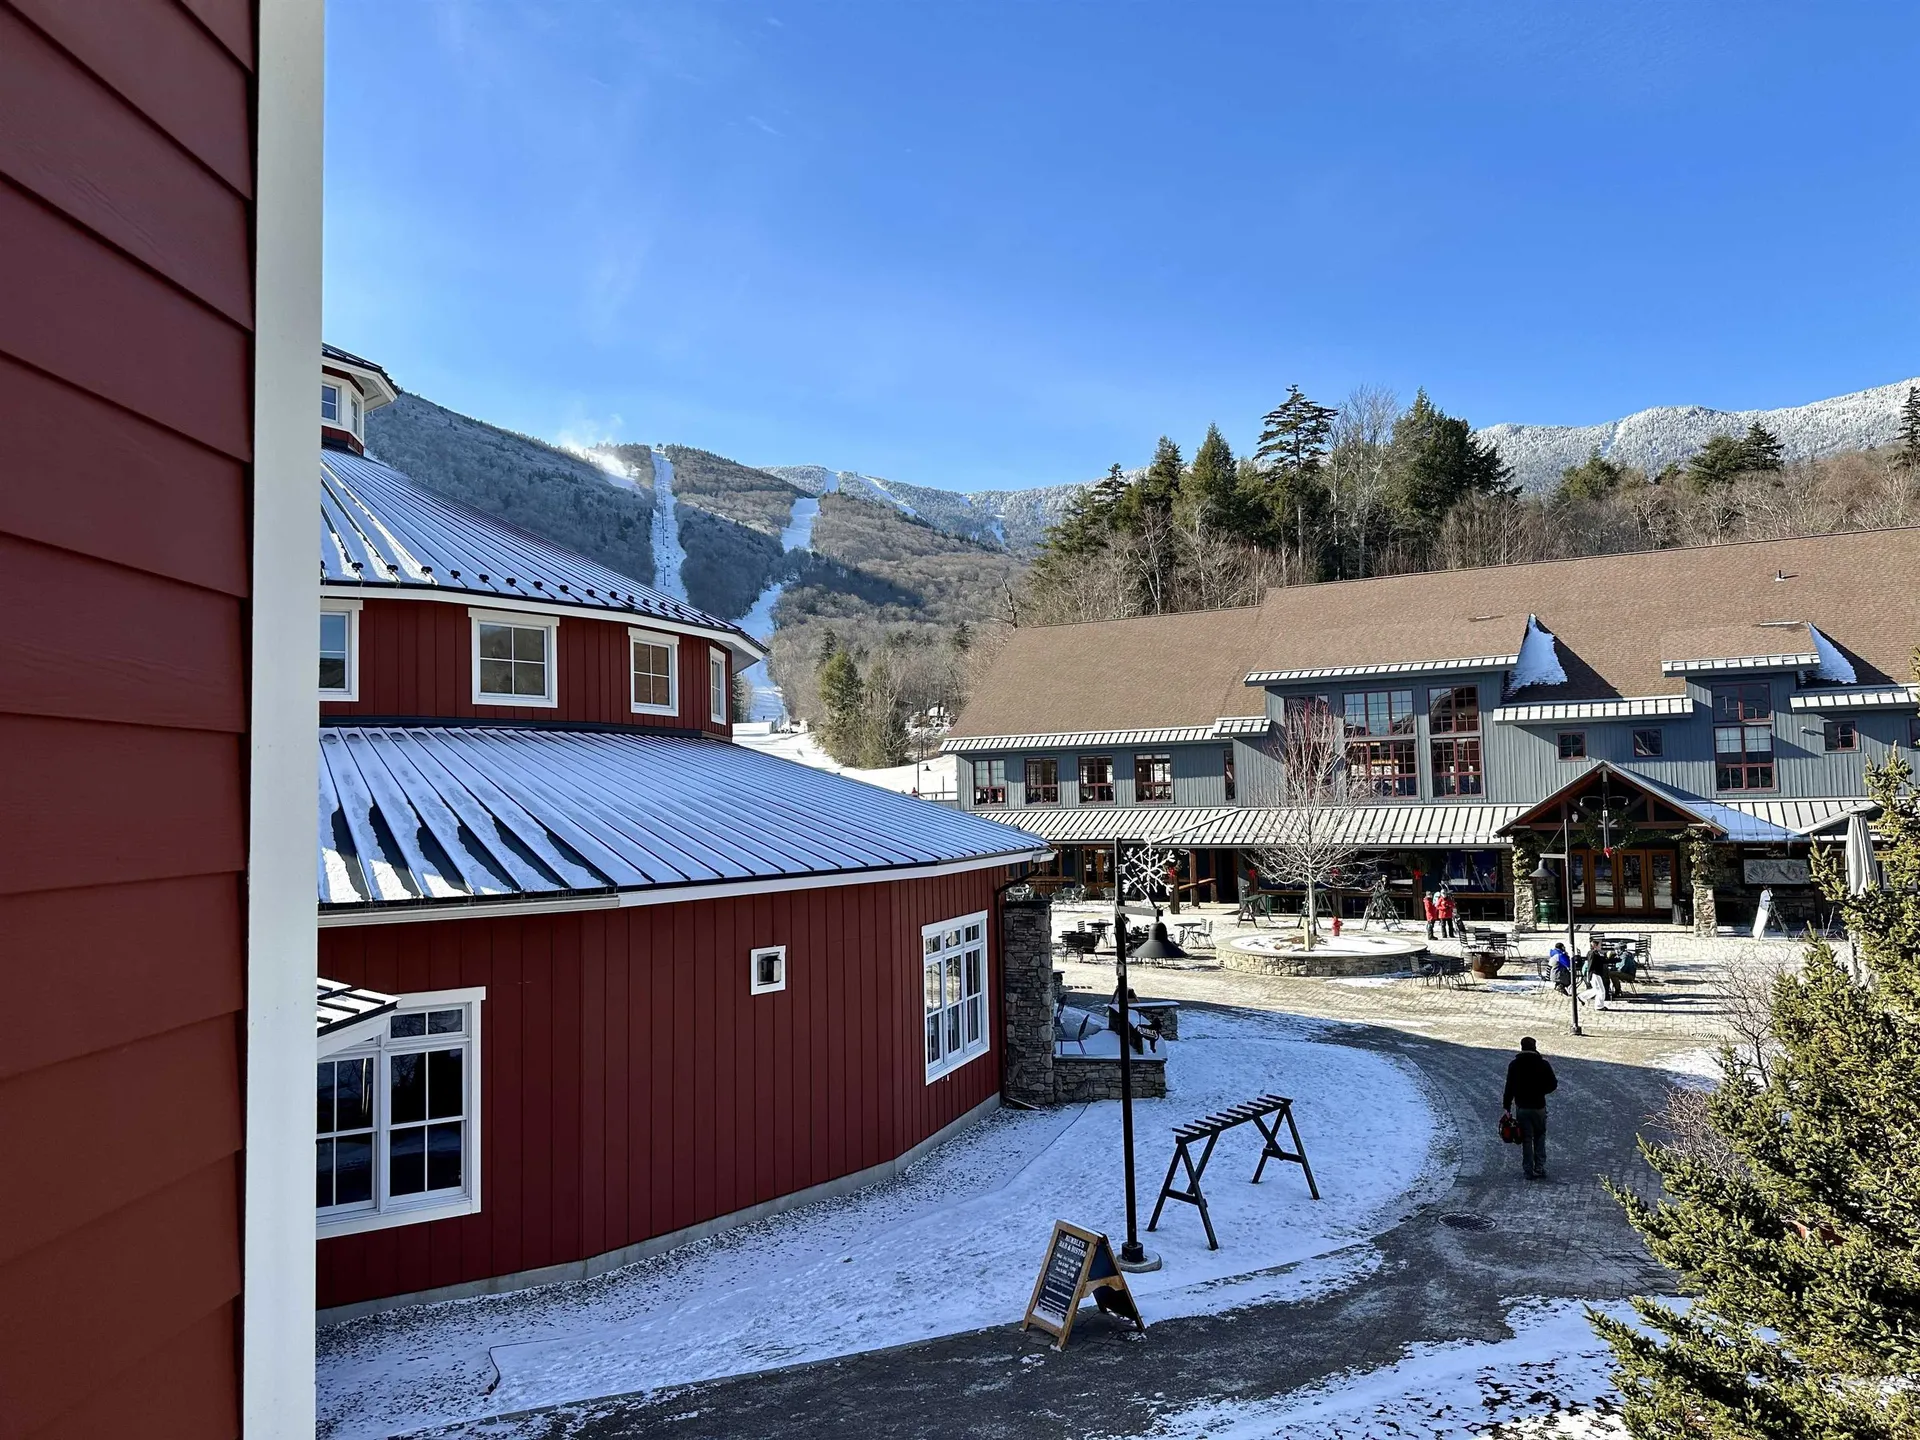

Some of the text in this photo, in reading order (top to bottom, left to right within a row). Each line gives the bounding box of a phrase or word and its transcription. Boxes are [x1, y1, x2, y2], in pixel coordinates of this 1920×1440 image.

[1058, 1240, 1069, 1249] BAR
[1070, 1245, 1087, 1258] BISTRO
[1064, 1234, 1086, 1249] RUMBLE'S
